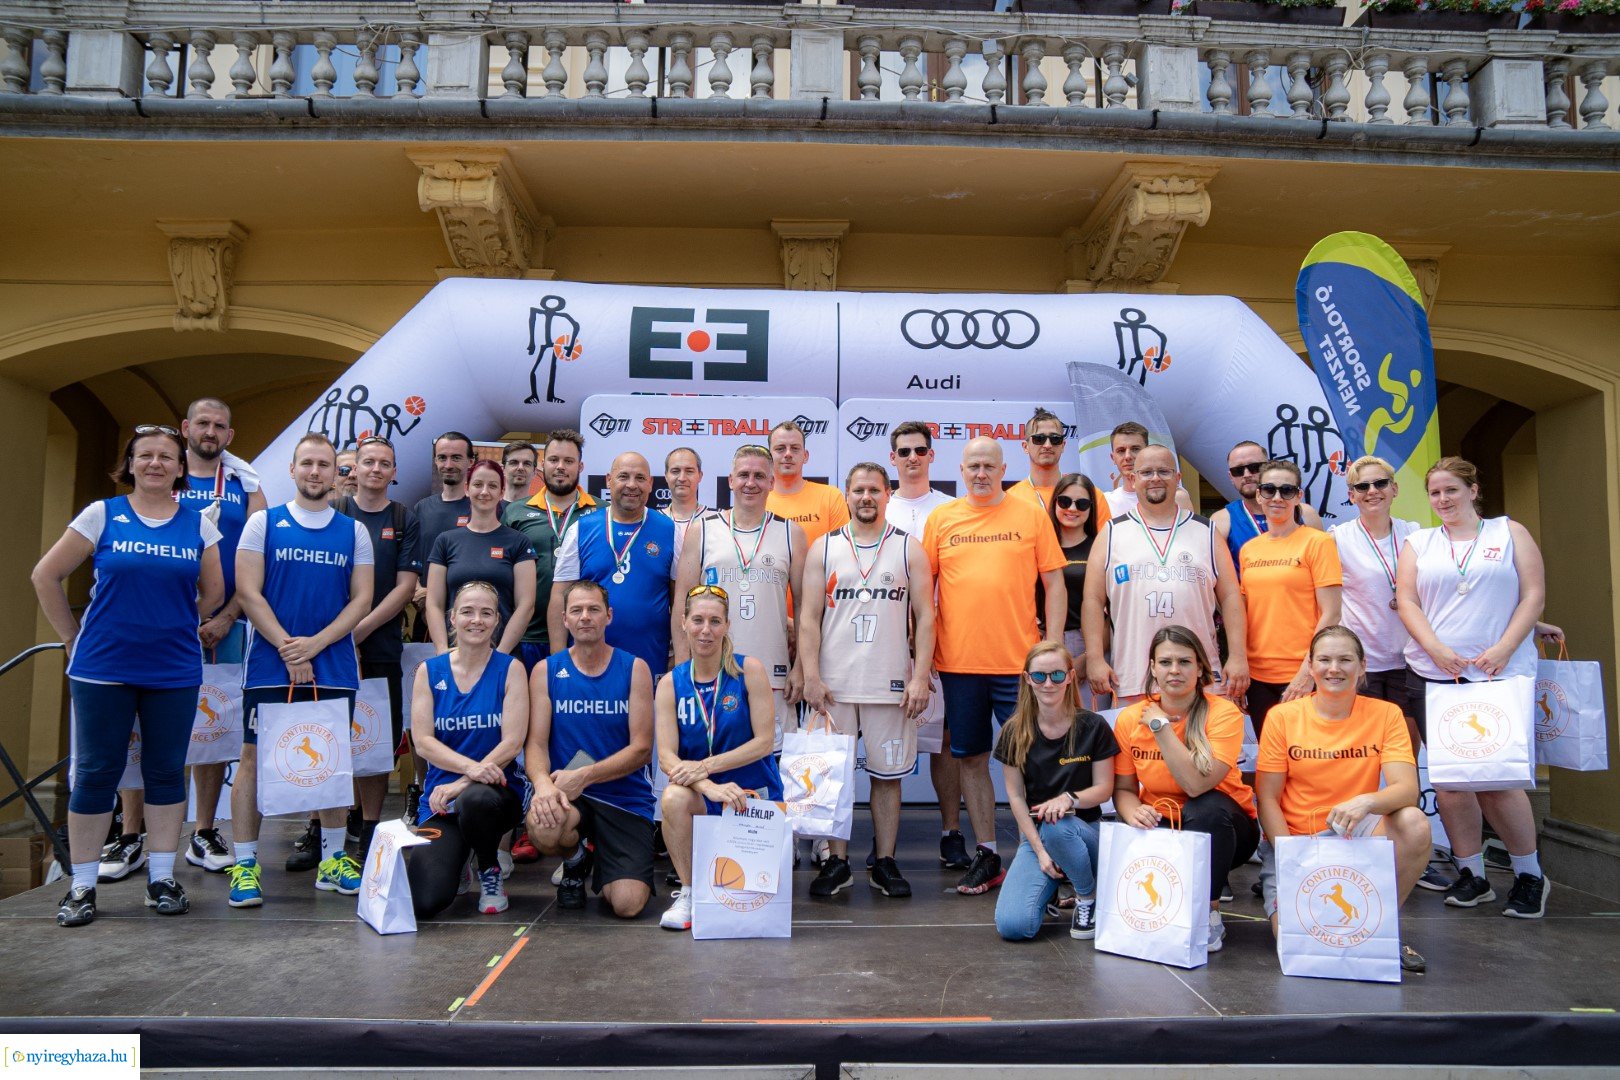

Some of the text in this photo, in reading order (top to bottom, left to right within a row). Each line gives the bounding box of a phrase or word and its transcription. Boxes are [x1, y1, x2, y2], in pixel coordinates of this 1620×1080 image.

[906, 374, 960, 389] Audi
[597, 418, 633, 433] TOTI
[642, 417, 772, 436] STREETBALL
[856, 422, 890, 437] TOTI
[950, 531, 1012, 547] Continental
[112, 540, 198, 562] MICHELIN
[275, 547, 348, 568] MICHELIN
[739, 594, 756, 621] 5
[1145, 590, 1175, 619] 14
[850, 614, 878, 643] 17
[556, 699, 629, 715] MICHELIN
[677, 696, 696, 725] 41
[1443, 702, 1506, 722] CONTINENTAL
[434, 712, 502, 731] MICHELIN
[279, 723, 336, 749] CONTINENTAL
[881, 738, 904, 767] 17
[1131, 746, 1164, 761] Contin
[1288, 744, 1368, 761] Continental
[1449, 742, 1501, 757] SINCE 1871
[285, 768, 333, 786] SINCE 1871
[1124, 858, 1180, 888] CONTINENTAL
[1301, 868, 1374, 897] CONTINENTAL
[719, 893, 770, 910] SINCE 1871
[1122, 909, 1168, 930] SINCE 1871
[1309, 925, 1370, 946] SINCE 1871
